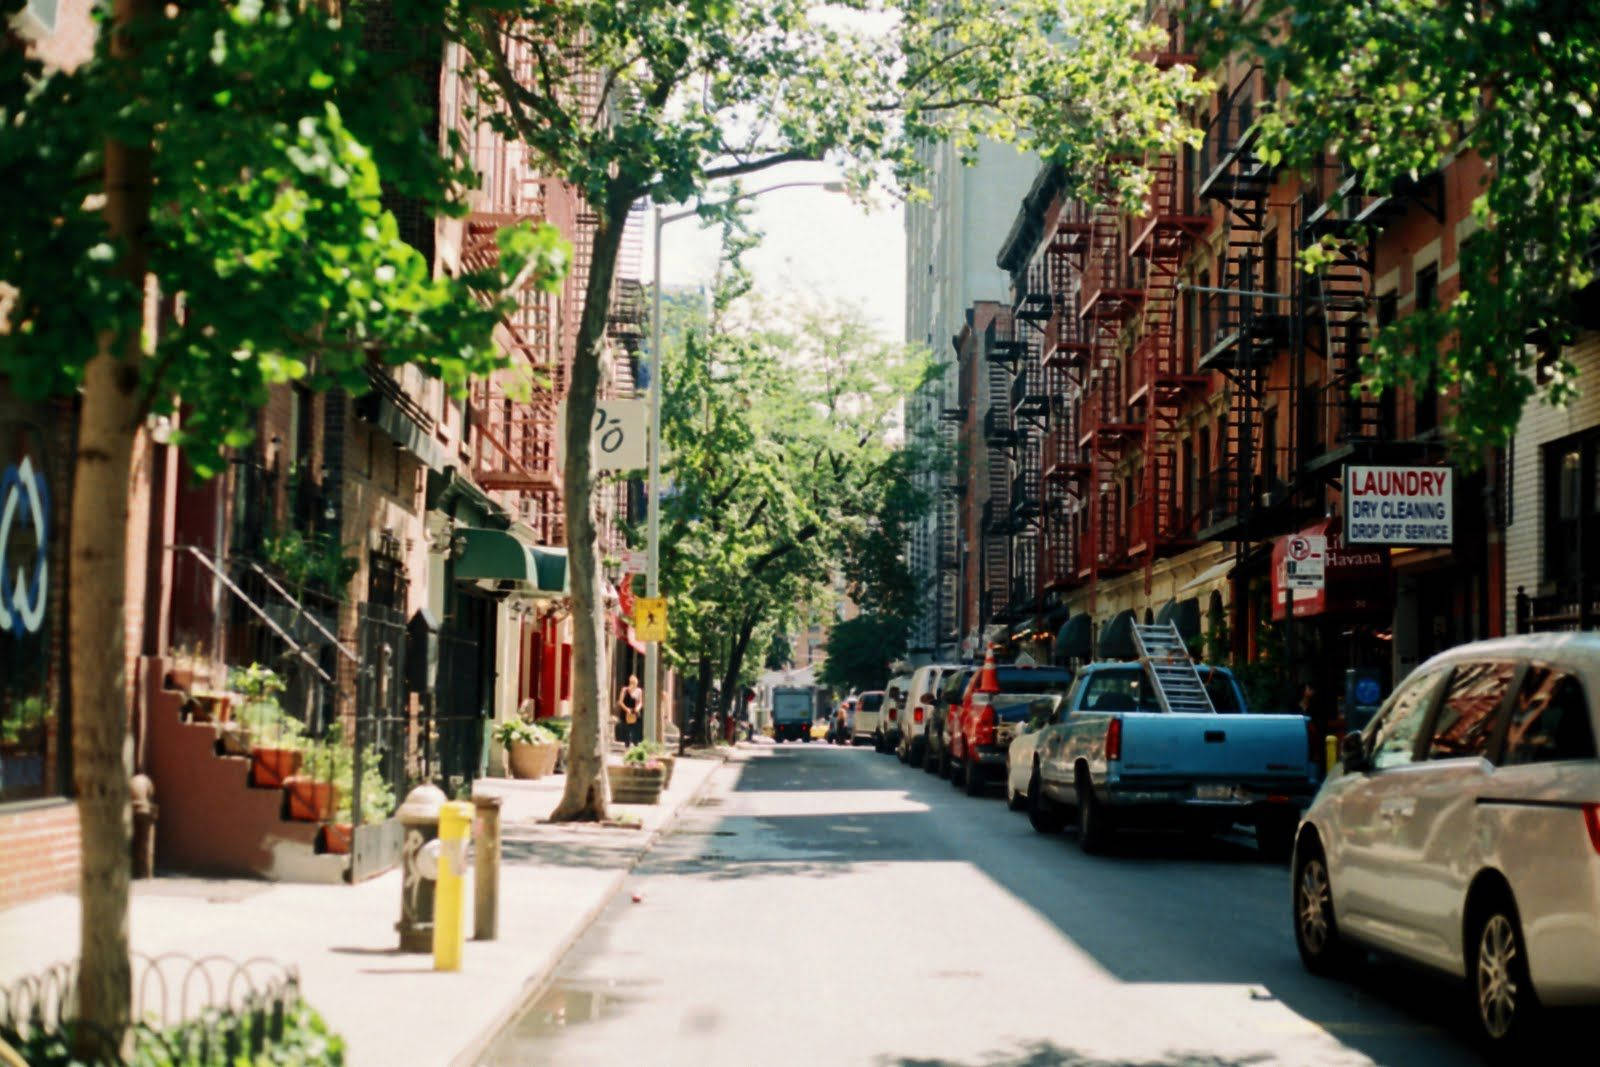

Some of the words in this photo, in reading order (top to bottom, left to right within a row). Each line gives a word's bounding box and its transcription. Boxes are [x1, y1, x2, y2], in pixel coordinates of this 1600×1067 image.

[1352, 471, 1447, 496] LAUNDRY
[1352, 501, 1378, 518] DRY
[1381, 501, 1446, 520] CLEANING
[1352, 523, 1380, 539] DROP
[1382, 524, 1402, 539] OFF
[1405, 525, 1448, 540] SERVICE
[1326, 553, 1381, 566] Havana
